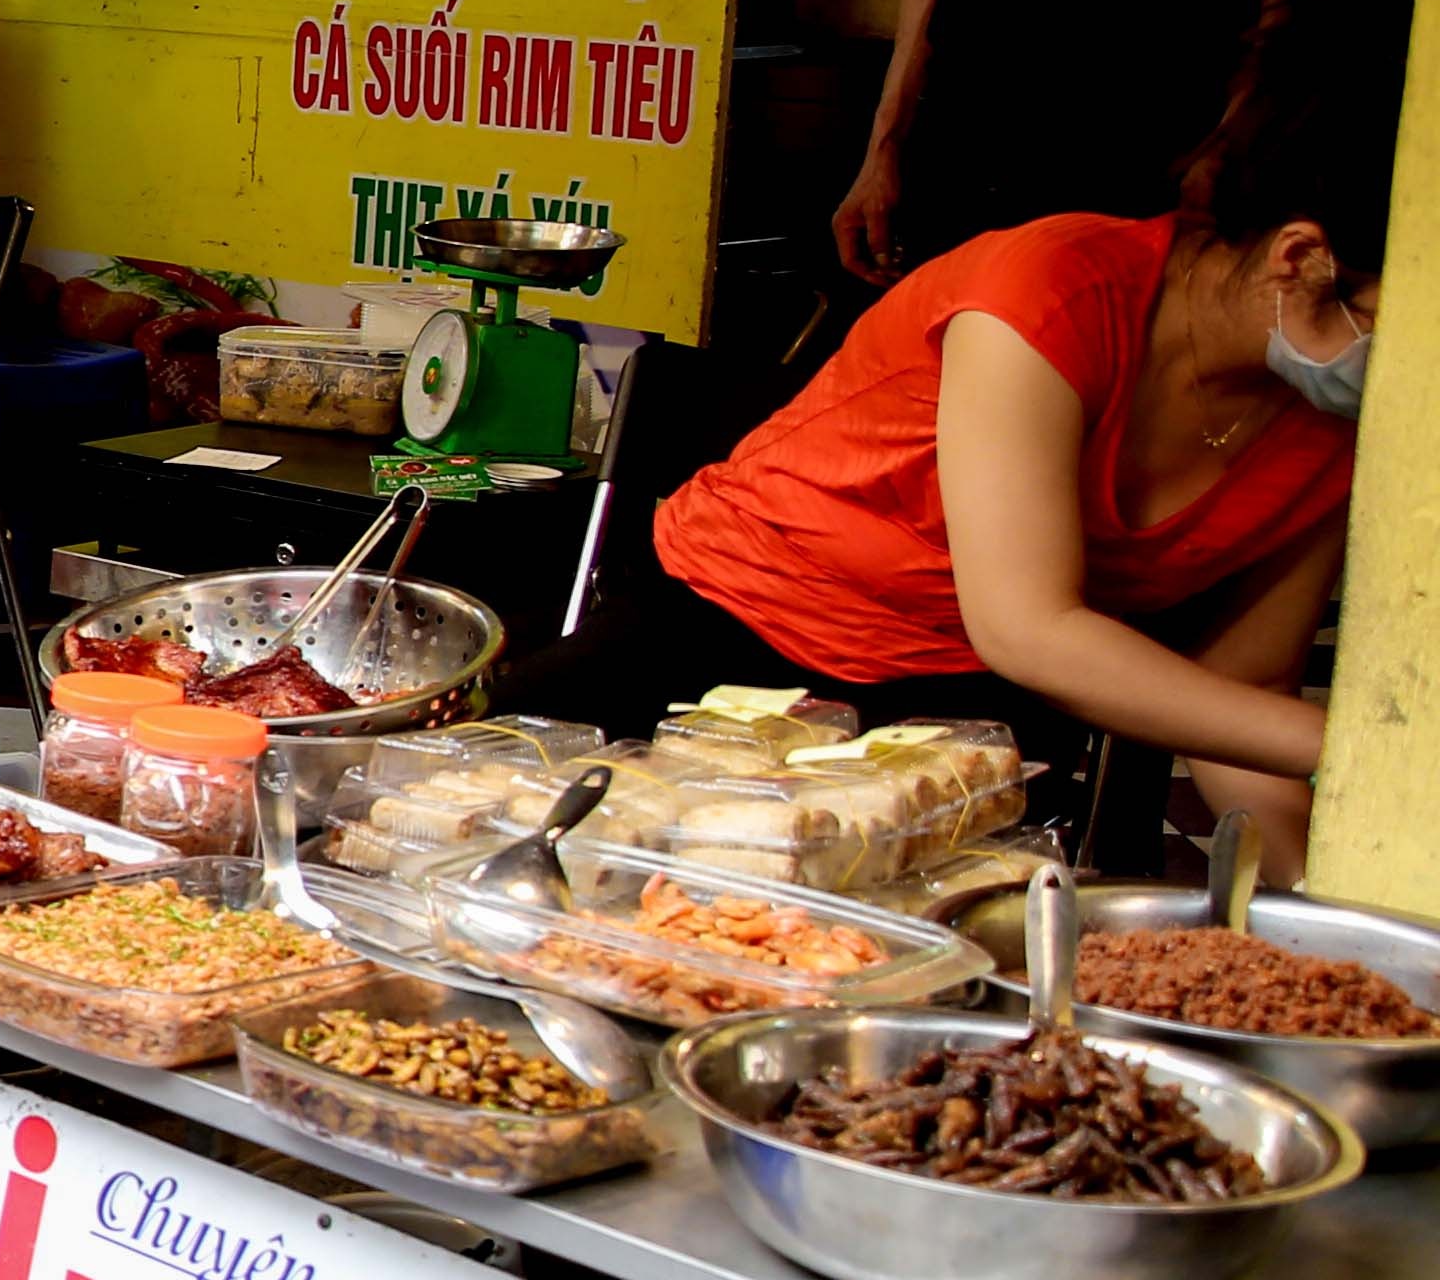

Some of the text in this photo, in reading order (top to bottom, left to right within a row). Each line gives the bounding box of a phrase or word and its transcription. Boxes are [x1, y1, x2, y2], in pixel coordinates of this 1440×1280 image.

[292, 4, 351, 112] CÁ
[479, 33, 573, 133] RIM
[589, 24, 695, 145] TIÊU
